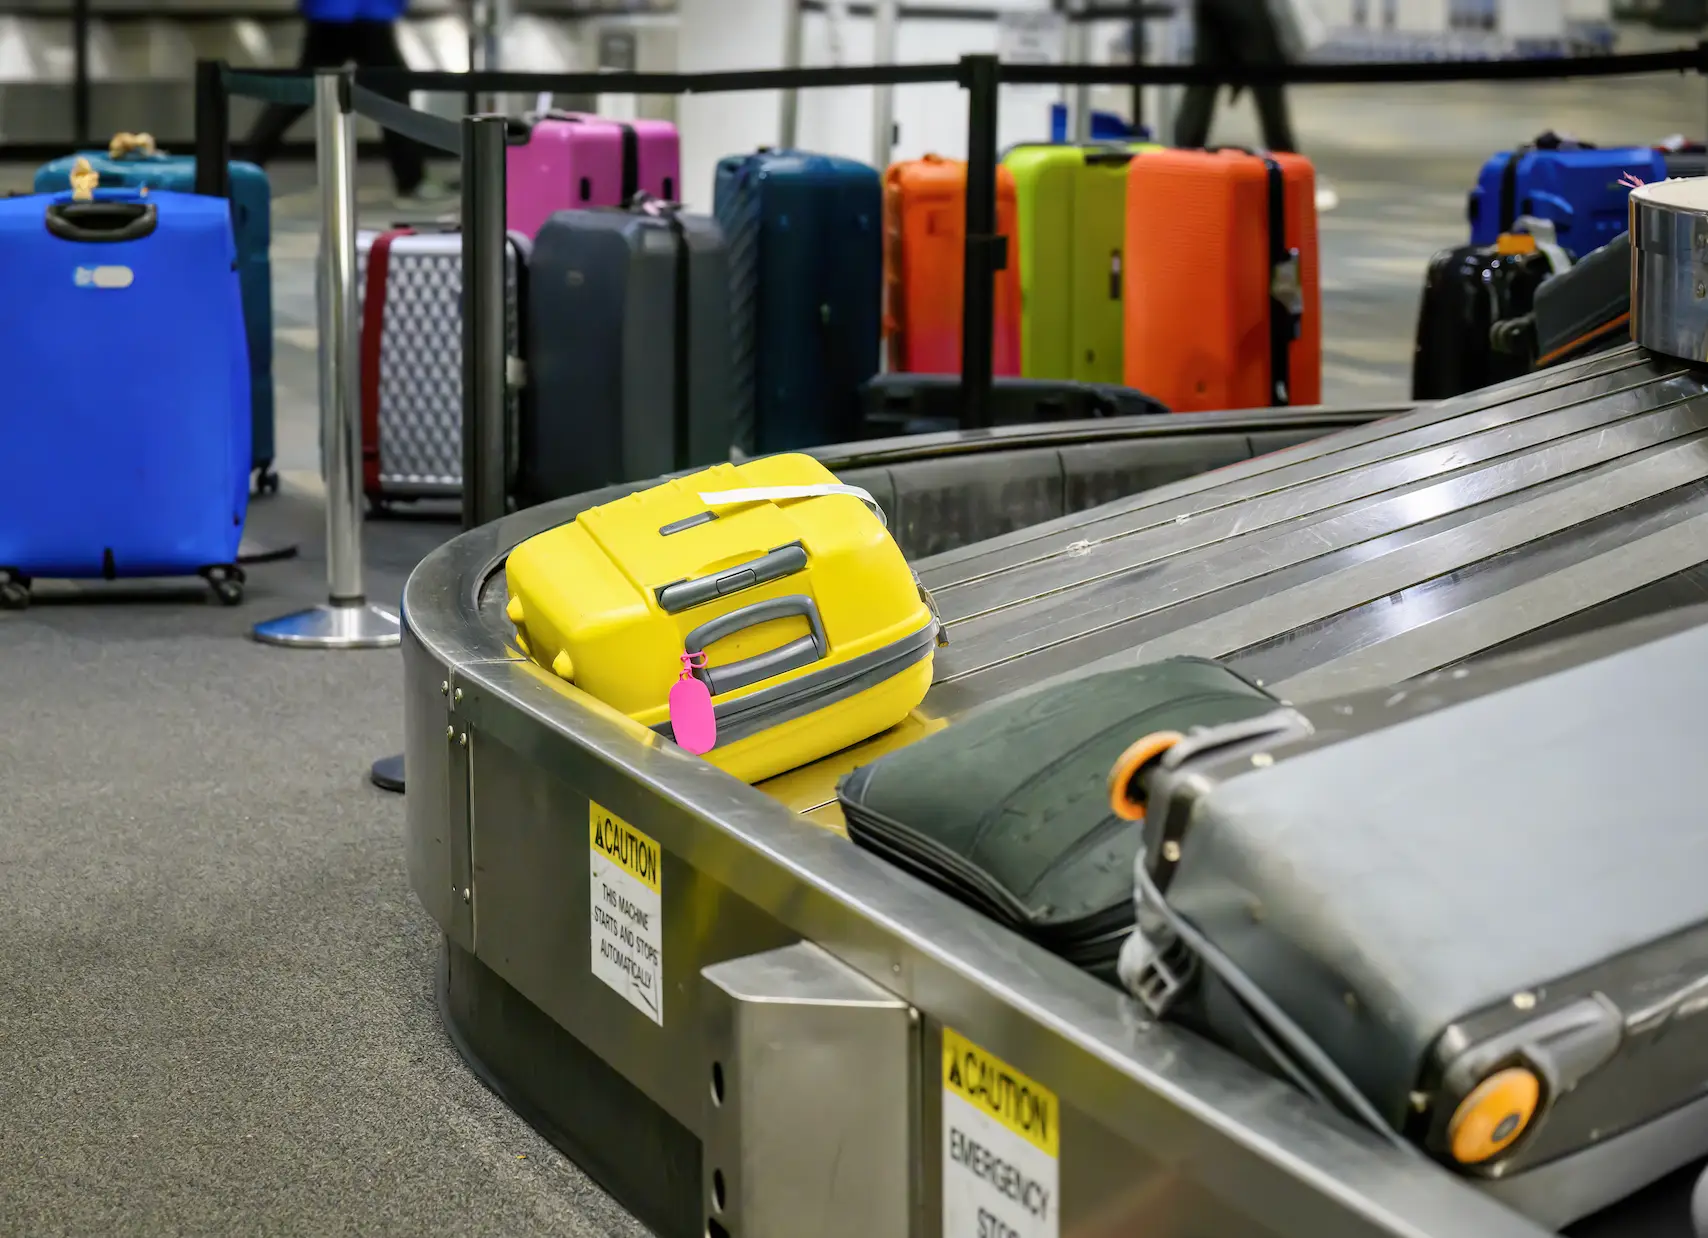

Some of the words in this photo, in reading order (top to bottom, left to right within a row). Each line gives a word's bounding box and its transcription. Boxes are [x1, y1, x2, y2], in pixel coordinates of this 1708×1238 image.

[604, 818, 656, 884] CAUTION
[594, 905, 618, 937] STARTS
[620, 924, 633, 948] AND
[636, 936, 658, 966] STOPS
[602, 883, 617, 908] THIS
[618, 895, 648, 931] MACHINE
[600, 938, 652, 989] AUTOMATICALLY
[965, 1052, 1047, 1142] CAUTION
[950, 1127, 1048, 1221] EMERGENCY
